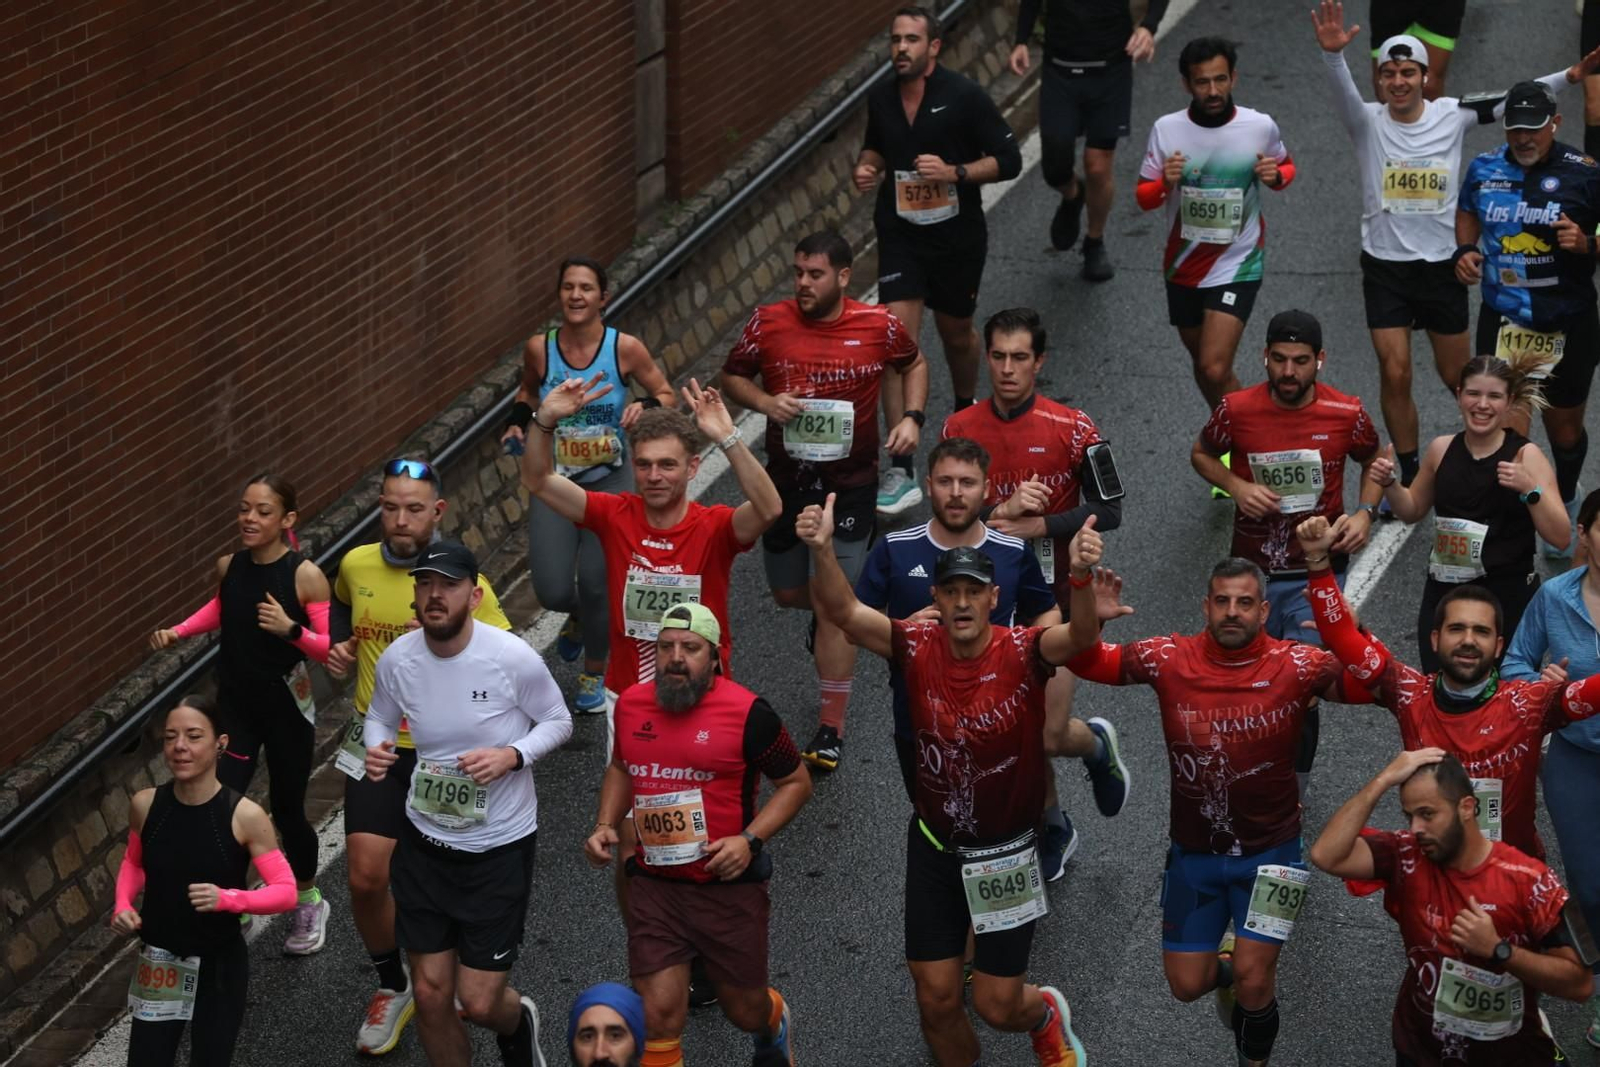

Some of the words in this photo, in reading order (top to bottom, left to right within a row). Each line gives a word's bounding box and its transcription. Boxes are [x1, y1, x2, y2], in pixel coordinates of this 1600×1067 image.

[905, 182, 941, 202] 5731
[1388, 172, 1438, 190] 14618
[1189, 202, 1226, 219] 6591
[1505, 331, 1554, 353] 11795
[796, 414, 835, 434] 7821
[560, 436, 611, 458] 10814
[1262, 465, 1305, 487] 6656
[636, 589, 682, 612] 7235
[650, 762, 717, 782] Lentos
[423, 778, 470, 806] 7196
[643, 810, 687, 834] 4063
[978, 871, 1027, 902] 6649
[1453, 980, 1507, 1013] 7965
